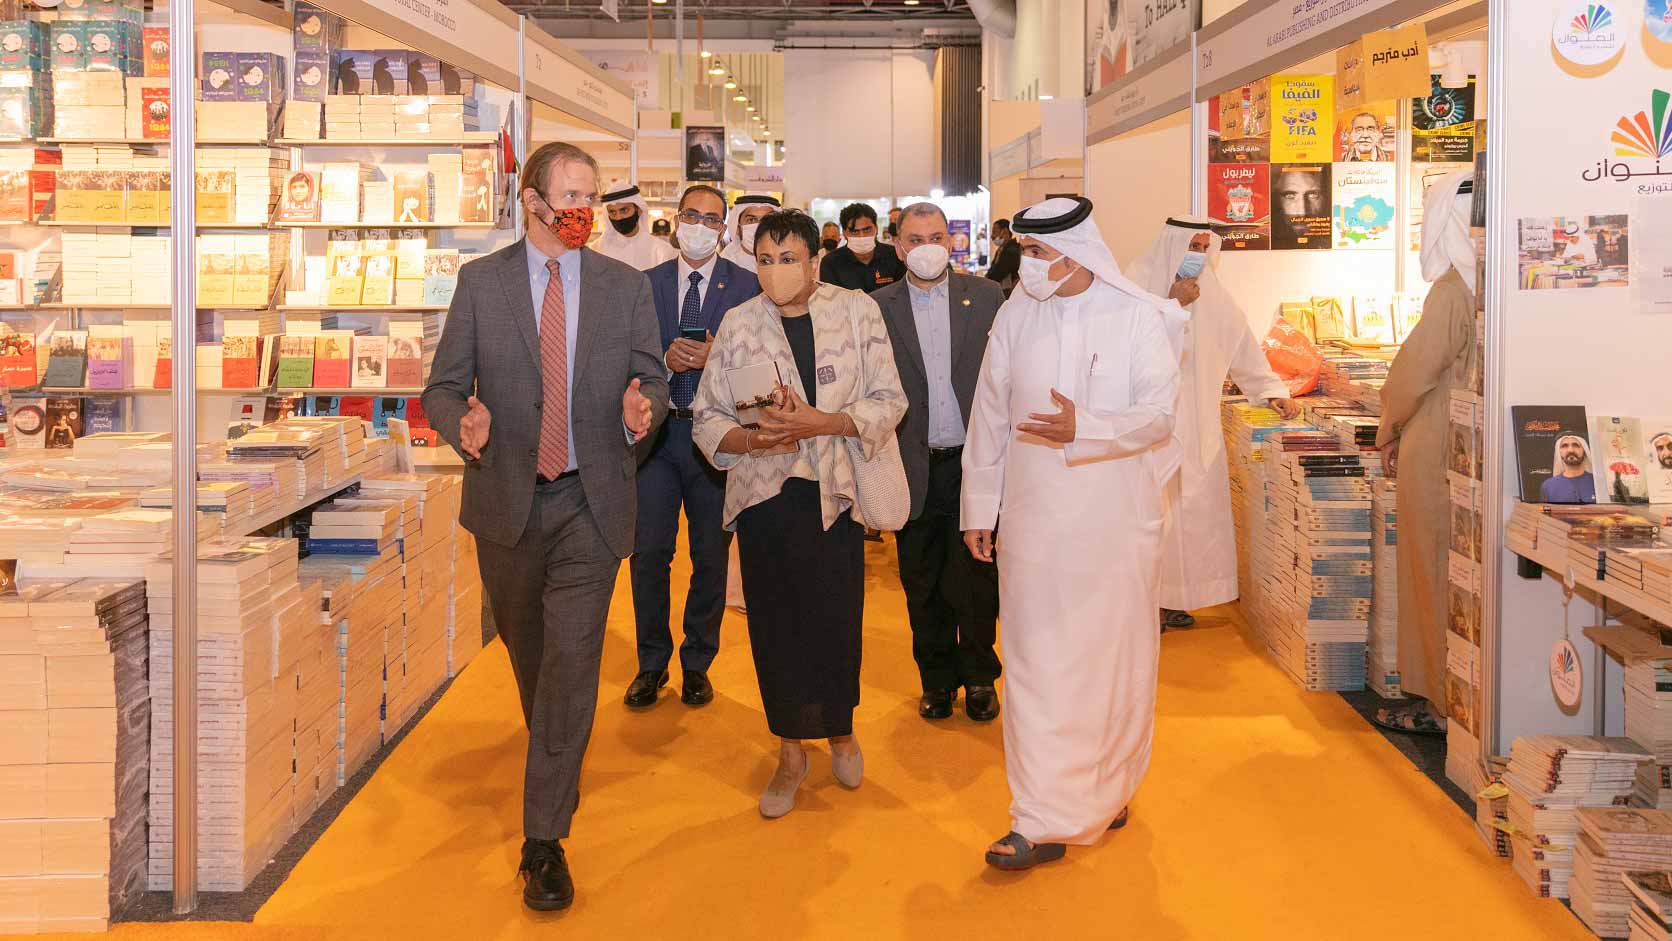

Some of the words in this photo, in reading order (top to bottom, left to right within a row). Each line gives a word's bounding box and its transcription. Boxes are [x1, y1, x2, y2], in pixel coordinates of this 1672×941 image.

[1144, 4, 1153, 28] To
[1156, 0, 1176, 20] HALL
[1316, 9, 1328, 25] AND
[1372, 48, 1400, 66] مترجم
[1402, 40, 1418, 60] أدب
[1282, 88, 1320, 102] الفيفا
[1289, 126, 1316, 136] FIFA
[1222, 168, 1256, 178] ليفربول
